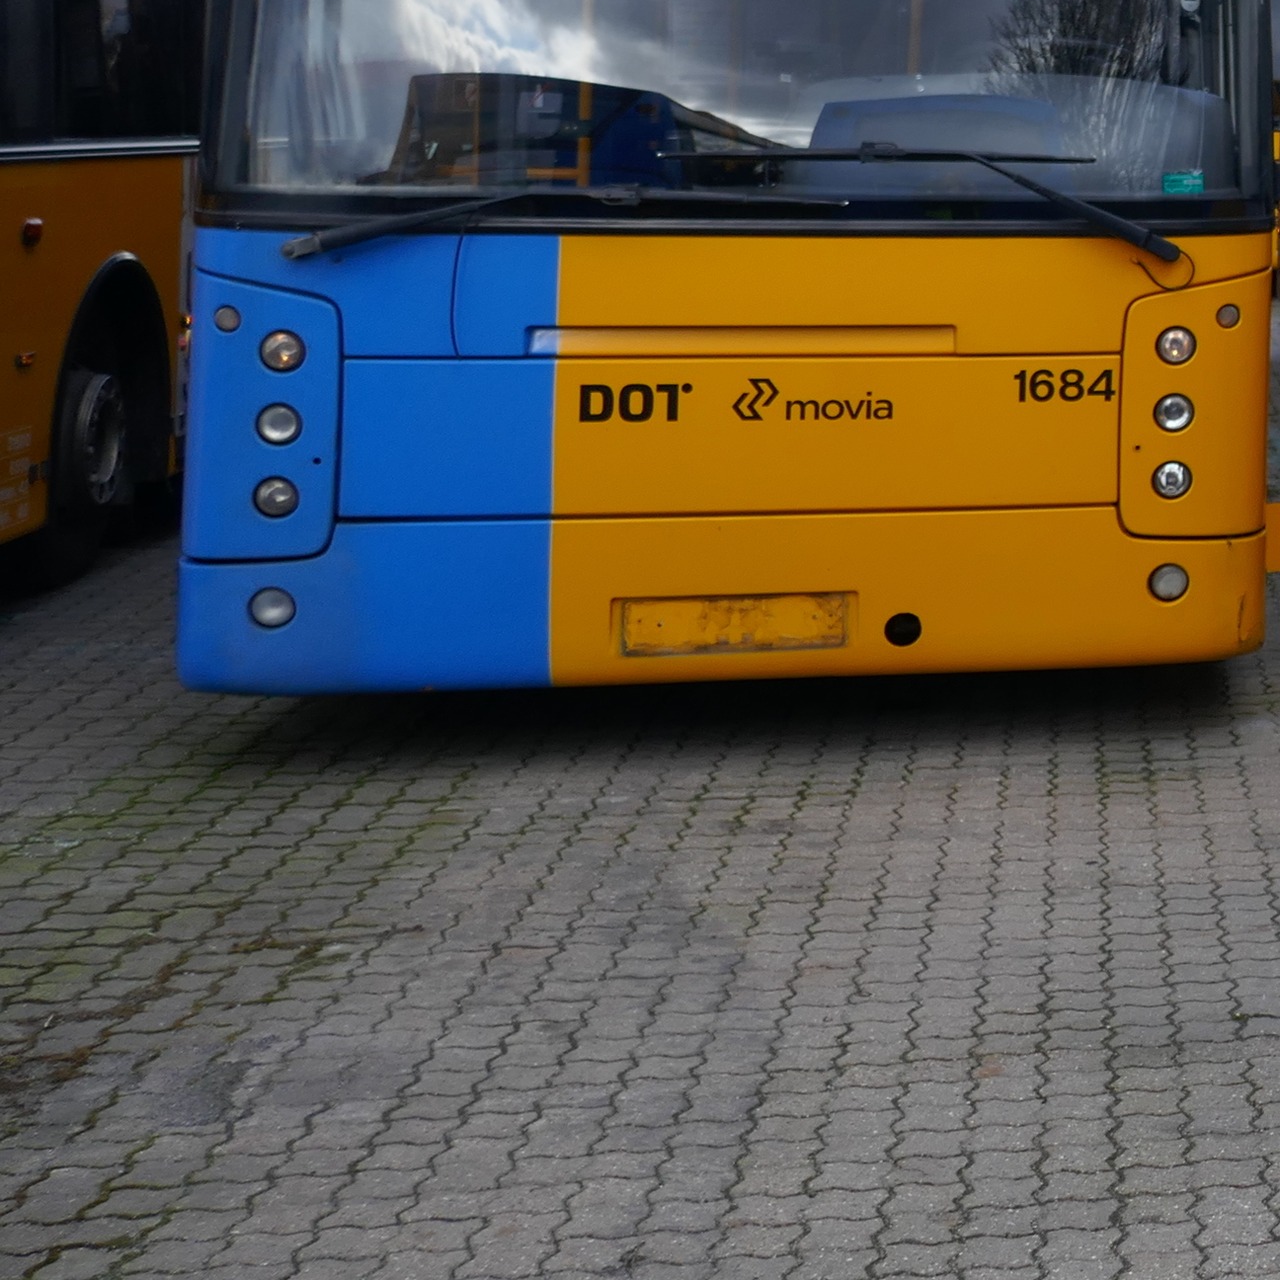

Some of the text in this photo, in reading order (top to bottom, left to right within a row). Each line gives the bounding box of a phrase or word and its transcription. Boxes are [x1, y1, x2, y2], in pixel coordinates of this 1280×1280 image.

[578, 382, 894, 423] DOT movia
[1013, 369, 1117, 404] 1684
